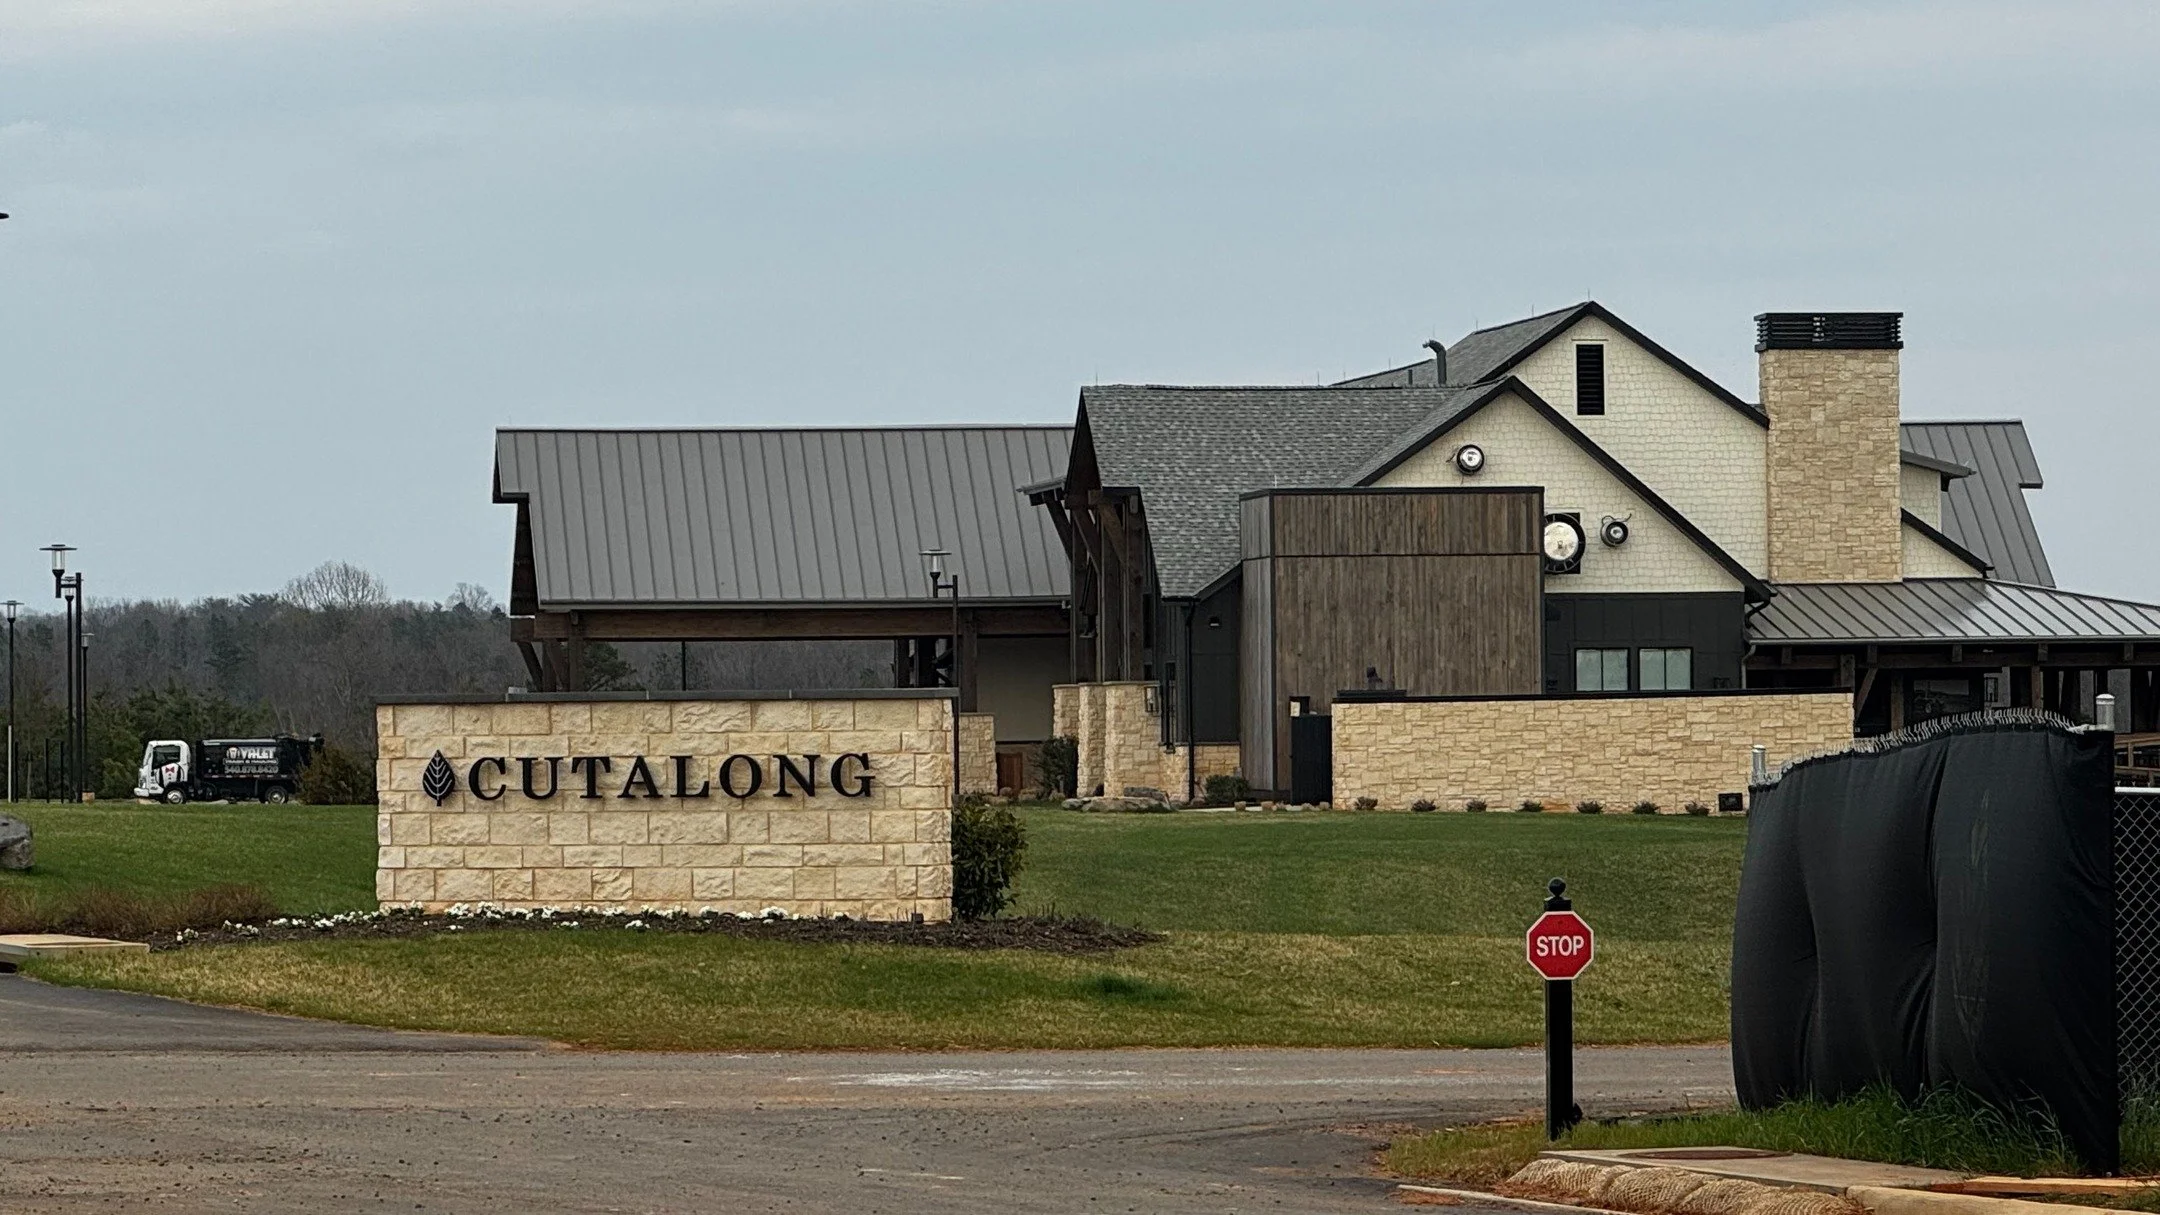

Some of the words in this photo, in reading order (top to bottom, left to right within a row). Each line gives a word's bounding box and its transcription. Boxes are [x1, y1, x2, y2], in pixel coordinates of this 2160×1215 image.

[240, 747, 277, 759] VALET
[468, 752, 877, 801] CUTALONG
[1536, 935, 1585, 957] STOP
